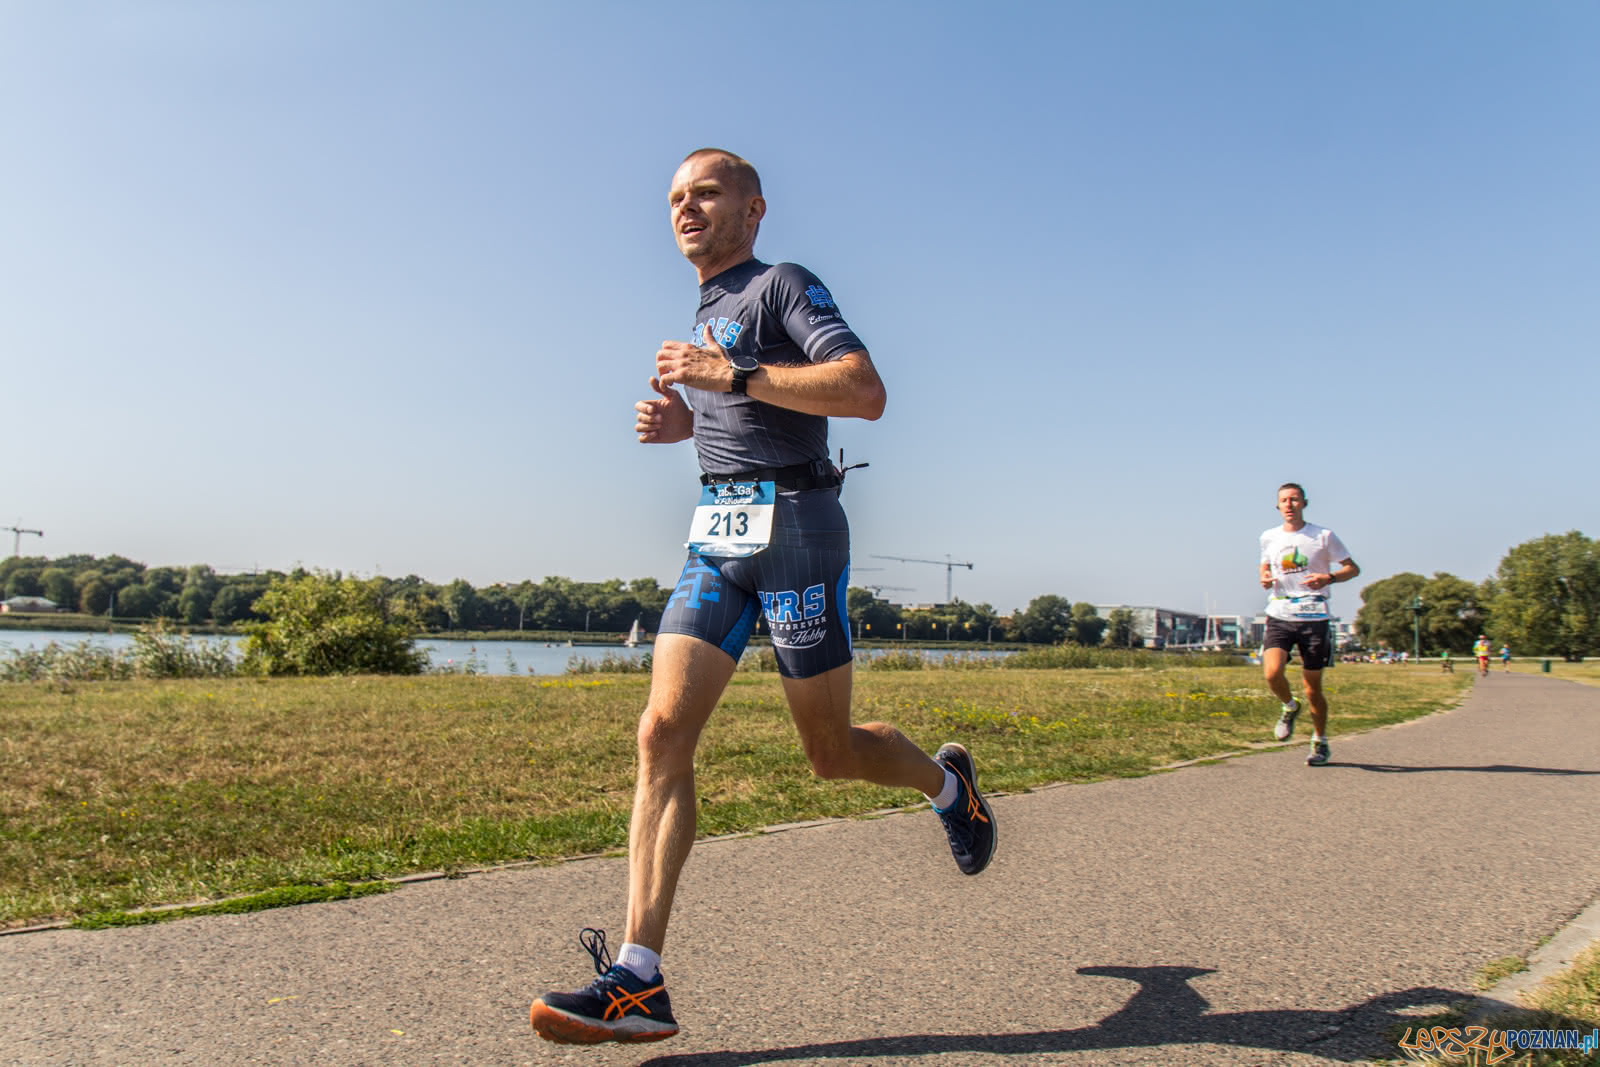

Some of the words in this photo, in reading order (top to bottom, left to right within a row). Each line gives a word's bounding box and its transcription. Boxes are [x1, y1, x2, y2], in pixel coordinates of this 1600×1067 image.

[707, 511, 748, 537] 213
[757, 583, 825, 622] HRS
[779, 616, 827, 631] FOREVER
[789, 627, 827, 645] Hobby
